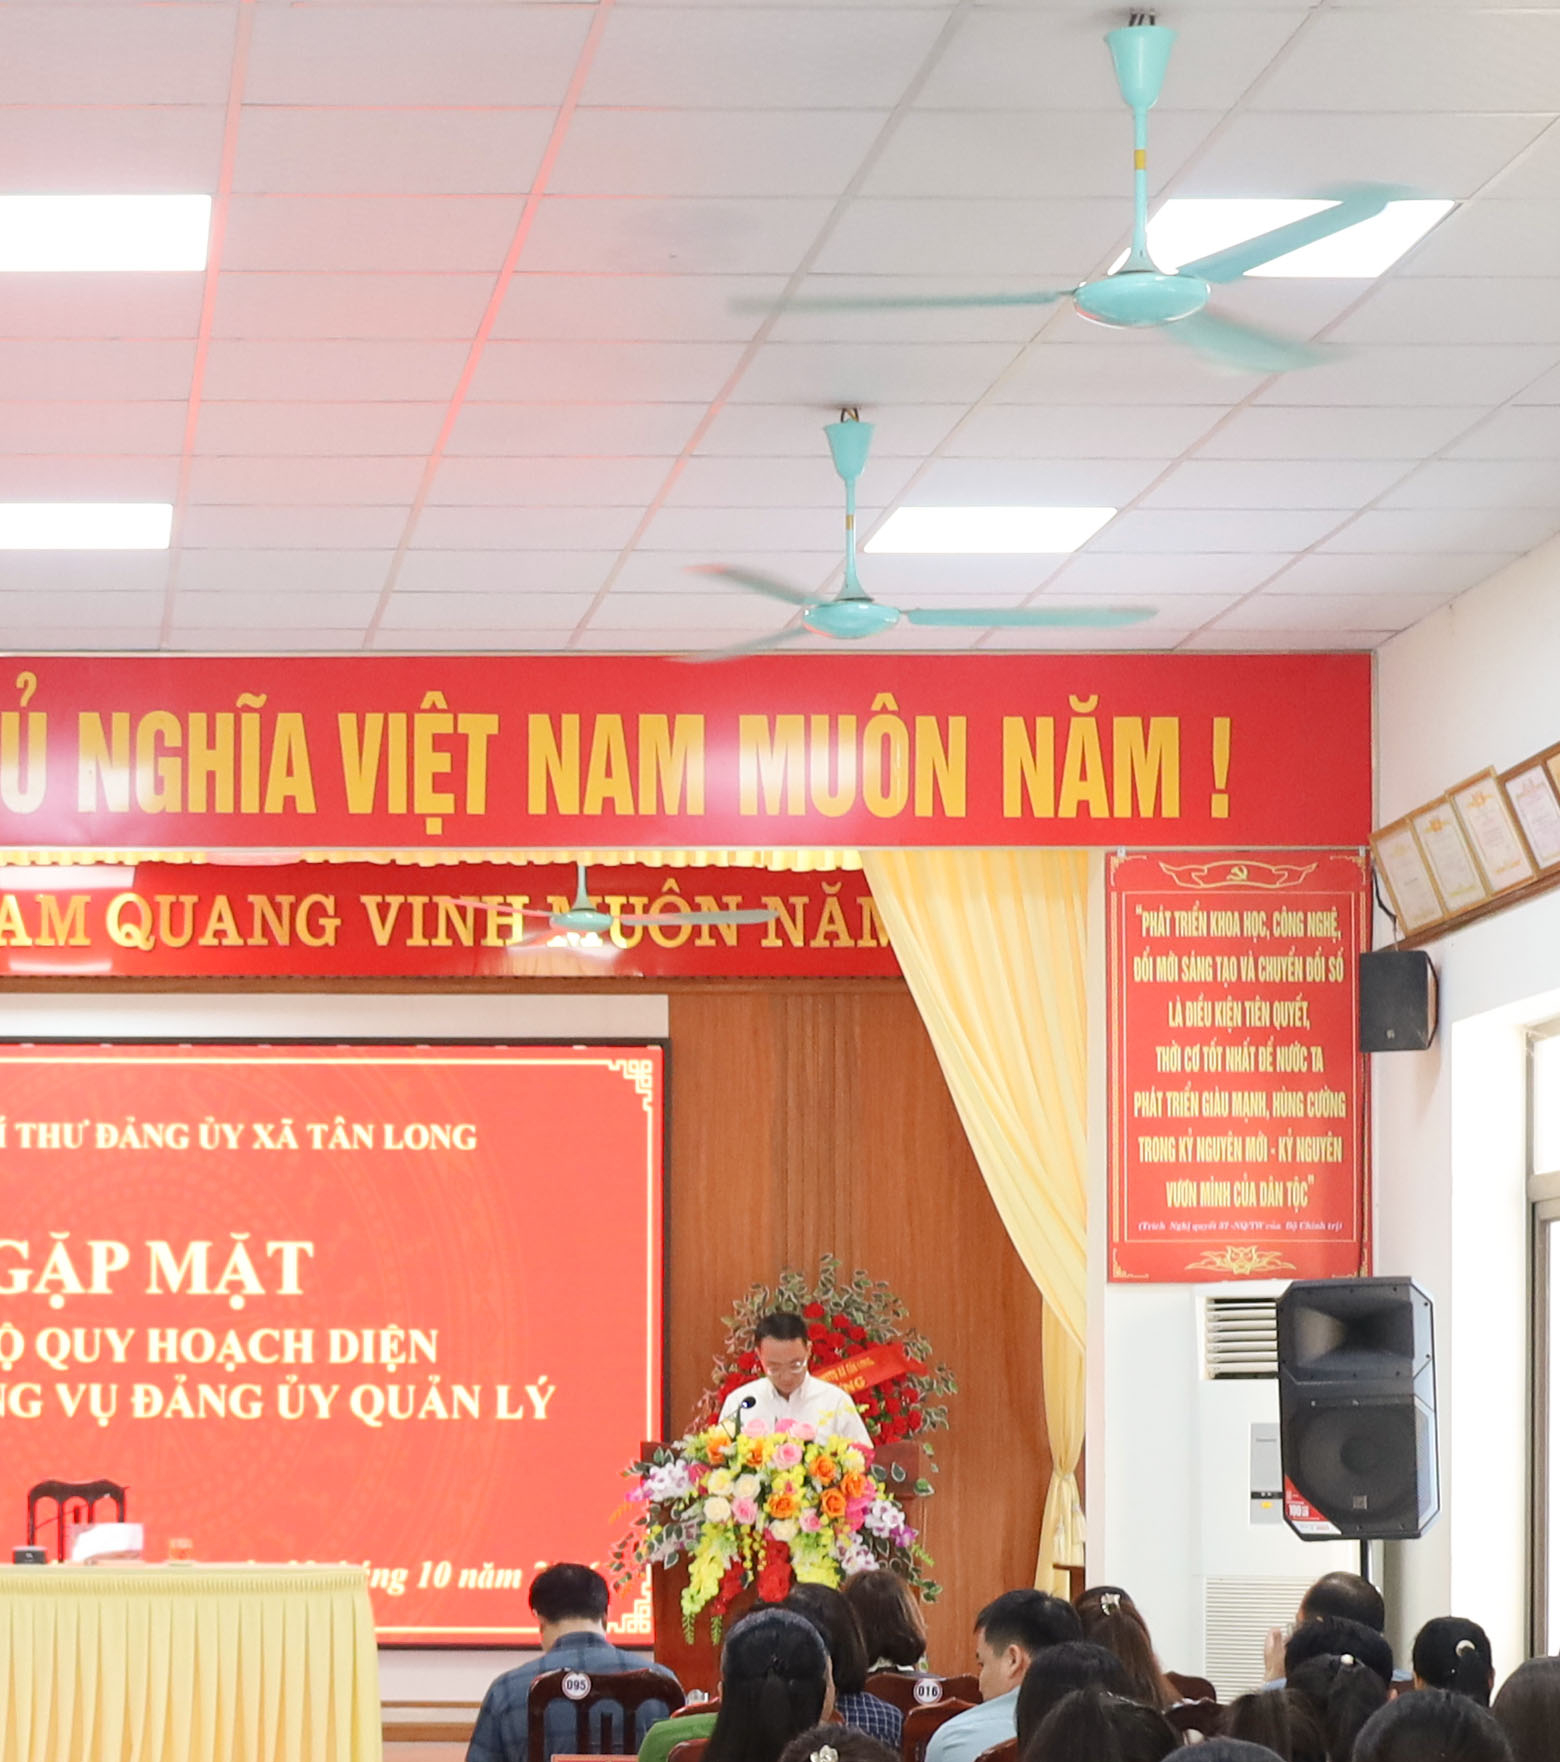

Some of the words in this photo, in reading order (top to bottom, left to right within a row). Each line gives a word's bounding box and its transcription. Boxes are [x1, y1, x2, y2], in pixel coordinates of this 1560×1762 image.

[80, 693, 317, 813] NGHĨA
[338, 691, 500, 835] VIỆT
[528, 713, 705, 815] NAM
[740, 693, 968, 817] MUÔN
[1003, 694, 1181, 818] NĂM
[1211, 717, 1232, 818] !
[106, 892, 342, 951] QUANG
[361, 895, 529, 948] VINH
[1174, 900, 1207, 937] TRIỂN
[1210, 911, 1240, 937] KHOA
[1243, 911, 1270, 943] HỌC,
[1273, 905, 1304, 937] CÔNG
[1307, 906, 1341, 943] NGHỆ,
[1133, 945, 1153, 982] ĐỔI
[1156, 950, 1178, 982] MỚI
[1181, 950, 1213, 982] SÁNG
[1216, 956, 1238, 988] TẠO
[1240, 950, 1255, 982] VÀ
[1258, 945, 1303, 982] CHUYỂN
[1306, 946, 1325, 982] ĐỔI
[1328, 946, 1344, 982] SỐ
[1168, 995, 1183, 1027] LÀ
[1185, 992, 1212, 1027] ĐIỀU
[1215, 995, 1242, 1033] KIỆN
[1244, 995, 1270, 1027] TIÊN
[1273, 992, 1310, 1031] QUYẾT,
[1156, 1040, 1181, 1072] THỜI
[1184, 1044, 1200, 1072] CƠ
[1203, 1037, 1223, 1072] TỐT
[1226, 1037, 1256, 1072] NHẤT
[1258, 1035, 1274, 1072] ĐỂ
[1276, 1041, 1308, 1072] NƯỚC
[1311, 1046, 1324, 1072] TA
[1134, 1085, 1162, 1117] PHÁT
[1166, 1080, 1199, 1117] TRIỂN
[1202, 1086, 1229, 1117] GIÀU
[1232, 1091, 1270, 1123] MẠNH,
[1272, 1086, 1304, 1117] HÙNG
[1307, 1085, 1347, 1118] CƯỜNG
[14, 1118, 90, 1150] THƯ
[95, 1115, 191, 1151] ĐẢNG
[198, 1115, 245, 1150] ỦY
[252, 1117, 299, 1150] XÃ
[306, 1115, 374, 1150] TÂN
[383, 1122, 478, 1151] LONG
[1138, 1136, 1176, 1162] TRONG
[1179, 1127, 1194, 1162] KỶ
[1197, 1130, 1242, 1162] NGUYÊN
[1245, 1130, 1268, 1162] MỚI
[1278, 1128, 1294, 1162] KỶ
[1296, 1131, 1343, 1162] NGUYÊN
[1166, 1179, 1197, 1208] VƯƠN
[1200, 1176, 1230, 1208] MÌNH
[1233, 1172, 1256, 1208] CỦA
[1259, 1176, 1283, 1208] DÂN
[144, 1231, 315, 1311] MẶT
[35, 1327, 136, 1372] QUY
[146, 1328, 315, 1372] HOẠCH
[327, 1322, 439, 1372] DIỆN
[54, 1382, 119, 1430] VỤ
[129, 1374, 265, 1420] ĐẢNG
[276, 1371, 341, 1421] ỦY
[348, 1374, 482, 1425] QUẢN
[494, 1375, 556, 1421] LÝ
[417, 1560, 452, 1590] 10
[458, 1560, 523, 1590] năm
[566, 1679, 587, 1691] 095
[918, 1685, 938, 1697] 016
